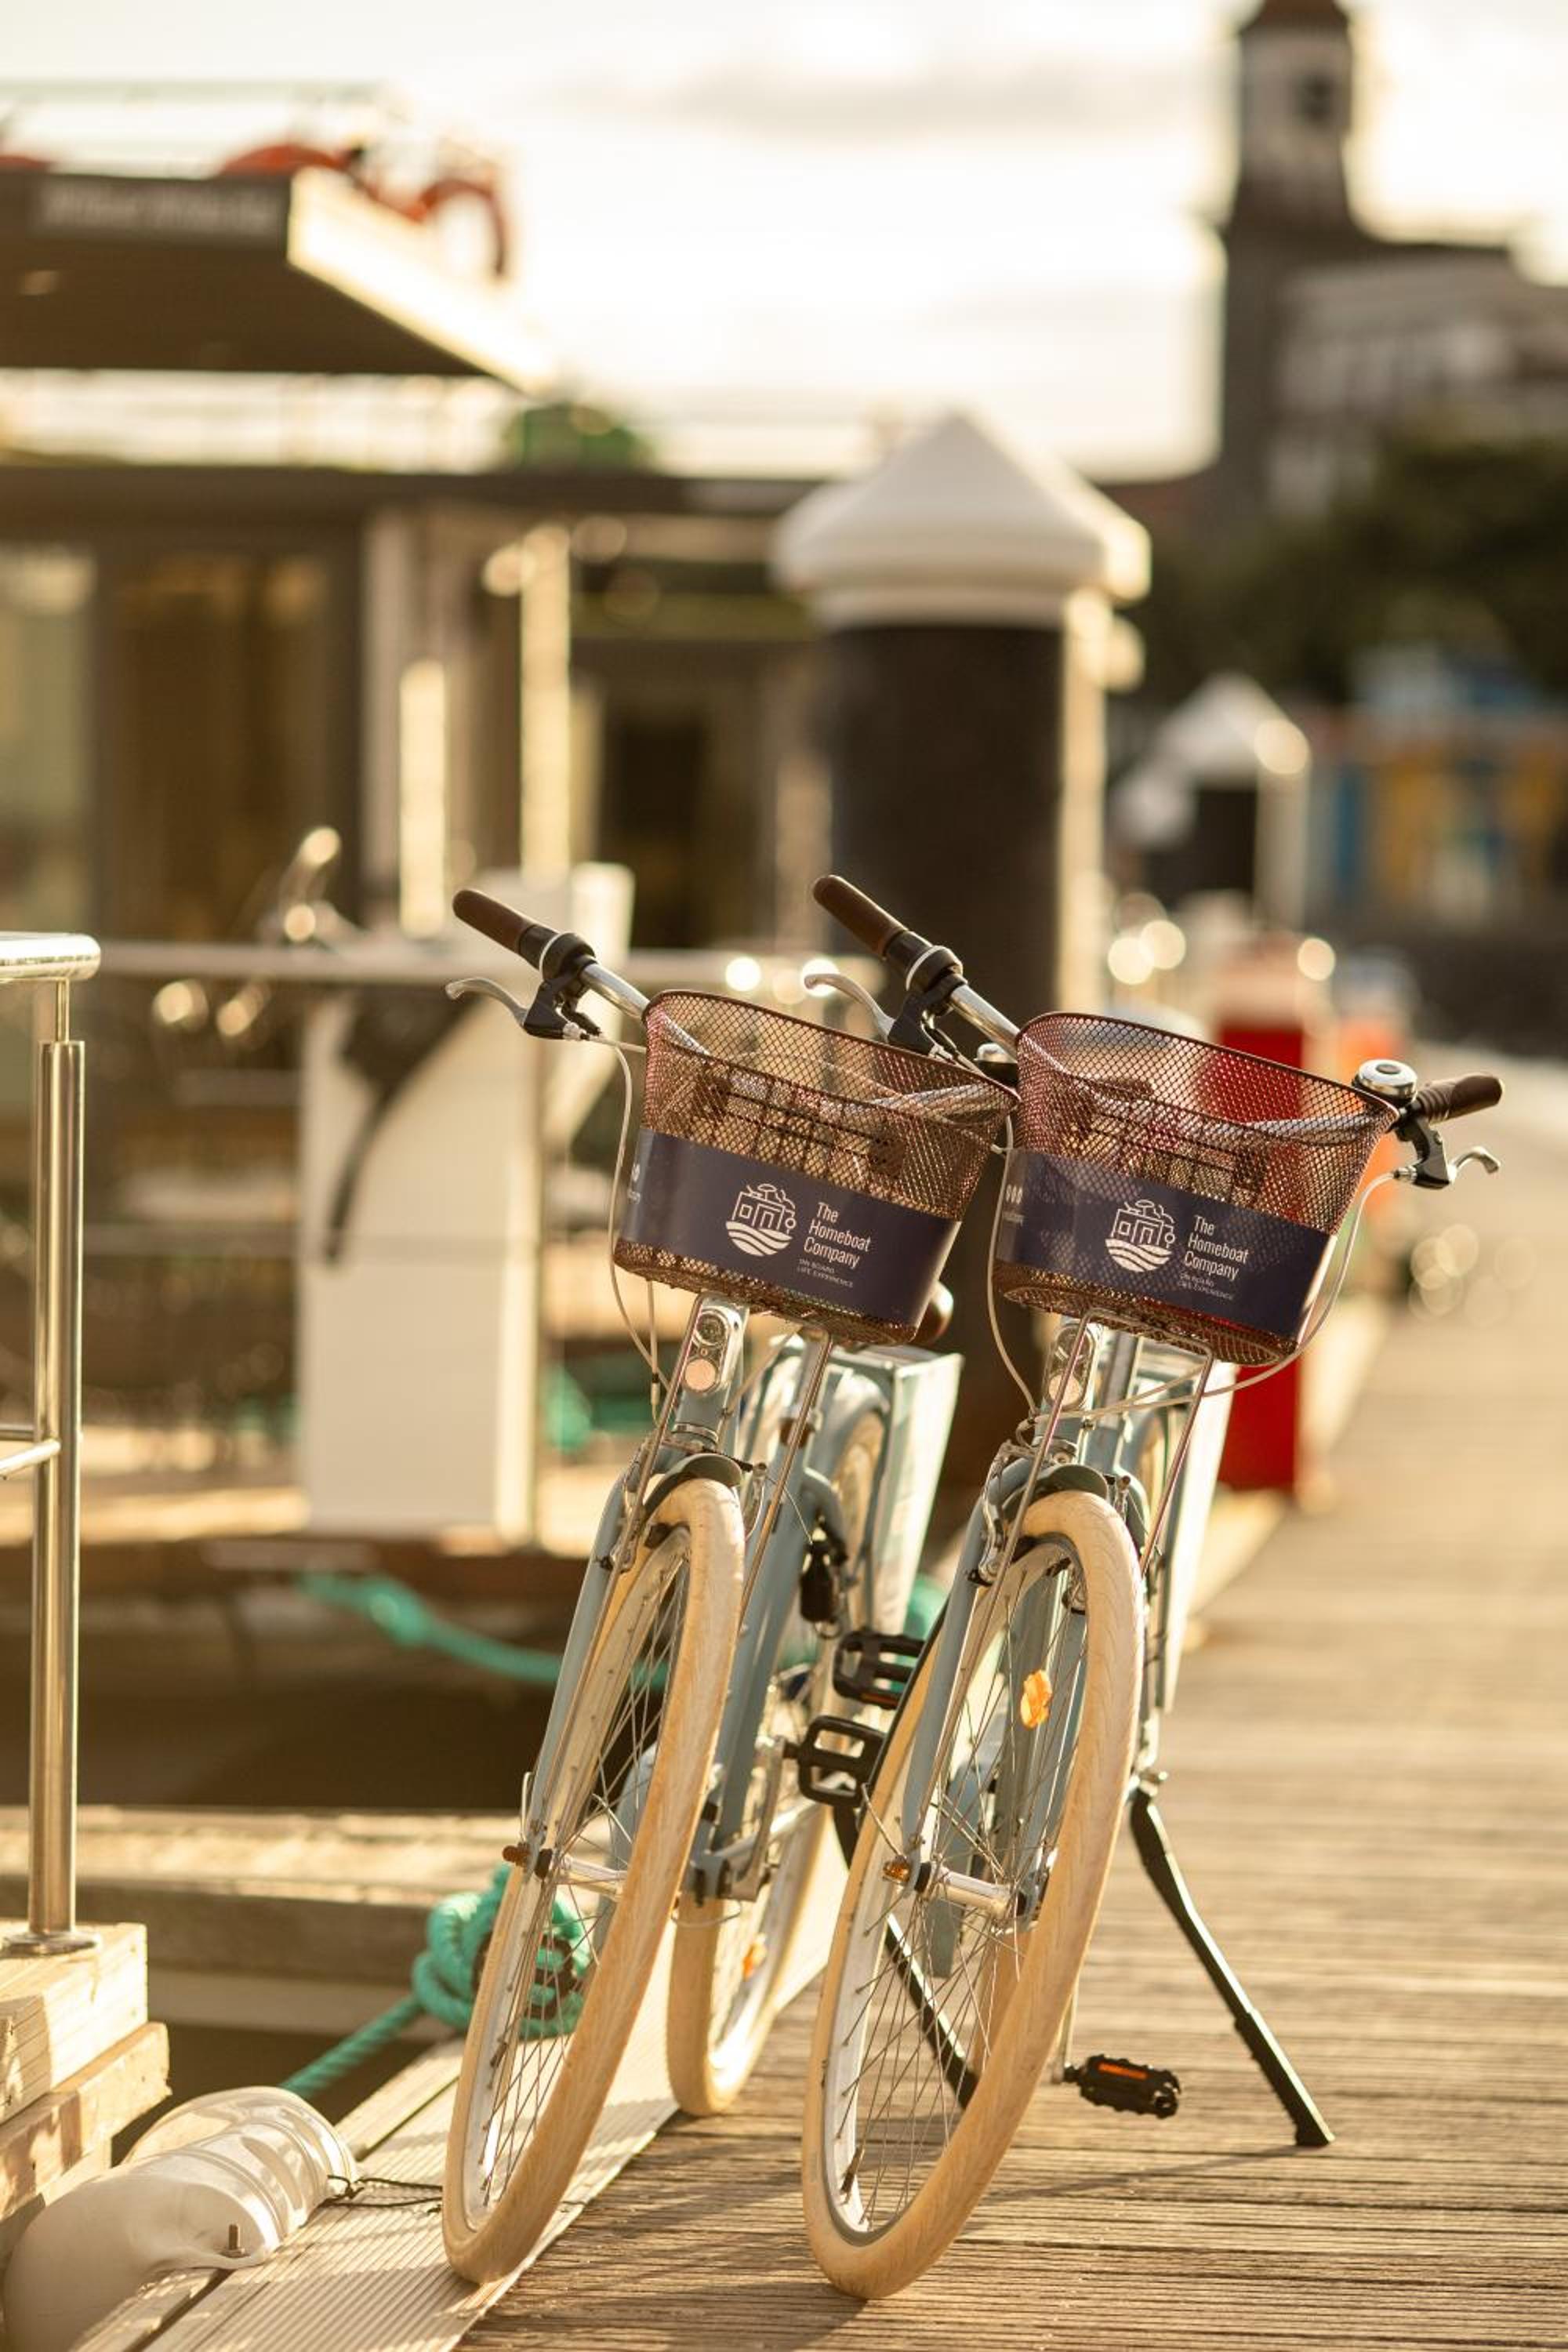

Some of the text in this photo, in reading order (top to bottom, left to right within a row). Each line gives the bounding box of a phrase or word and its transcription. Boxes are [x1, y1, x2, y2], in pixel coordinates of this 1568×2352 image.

[817, 1201, 839, 1223] The
[1193, 1214, 1215, 1236] The
[808, 1218, 871, 1252] Homeboat
[1187, 1232, 1249, 1265] Homeboat
[804, 1236, 860, 1270] Company
[1184, 1250, 1240, 1282] Company
